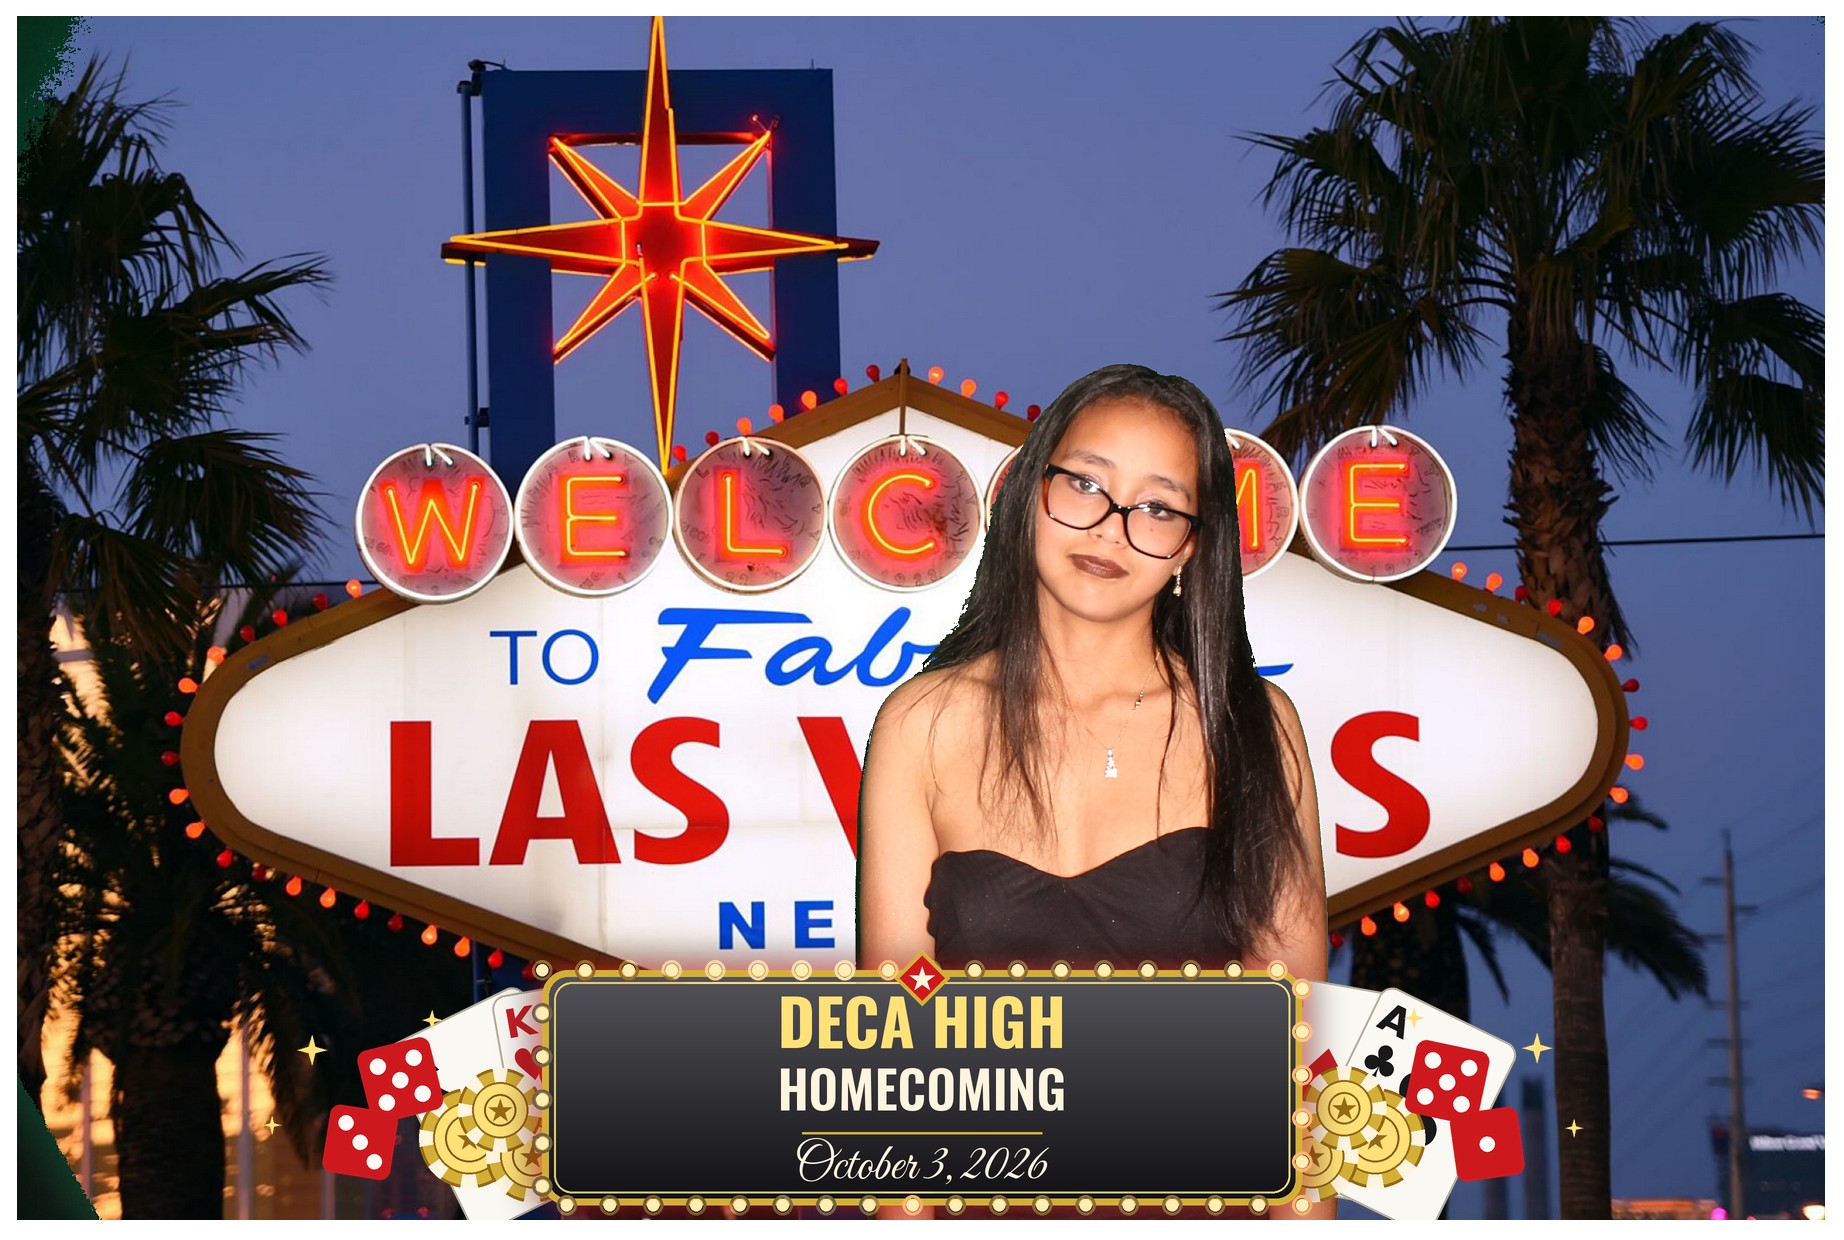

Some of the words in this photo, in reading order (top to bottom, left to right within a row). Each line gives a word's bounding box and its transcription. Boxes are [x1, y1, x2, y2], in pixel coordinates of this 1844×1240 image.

[380, 458, 1410, 573] WELCE
[491, 629, 600, 686] TO
[391, 716, 730, 867] LAS
